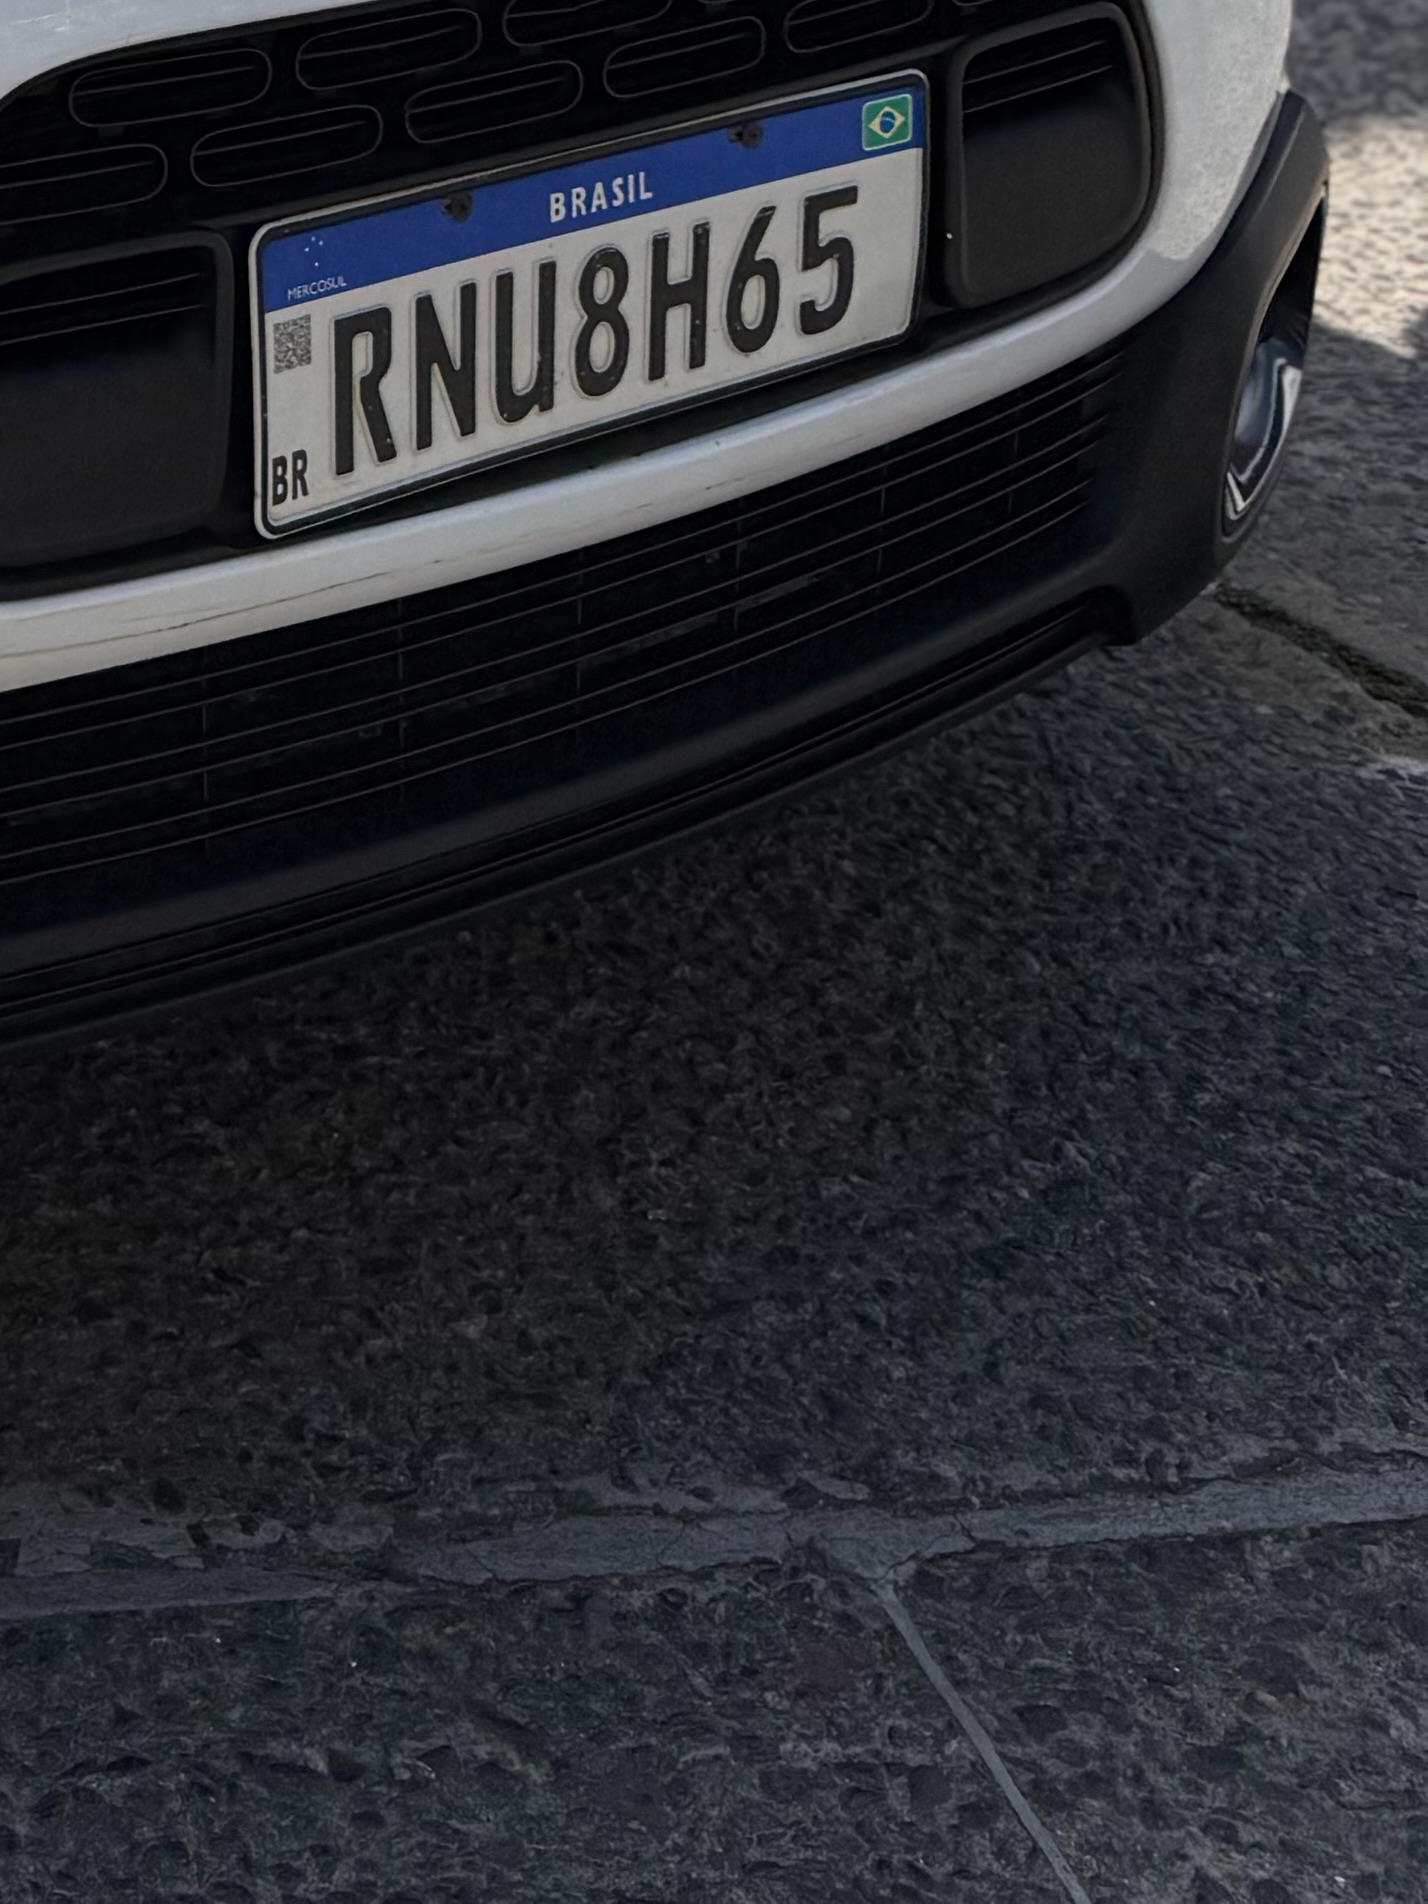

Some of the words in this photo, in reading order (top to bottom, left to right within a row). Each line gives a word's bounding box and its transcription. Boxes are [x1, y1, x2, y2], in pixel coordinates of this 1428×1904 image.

[549, 171, 653, 223] BRASIL
[287, 275, 347, 301] MERCOSUL
[333, 185, 859, 476] RNU8H65
[271, 449, 309, 506] BR
